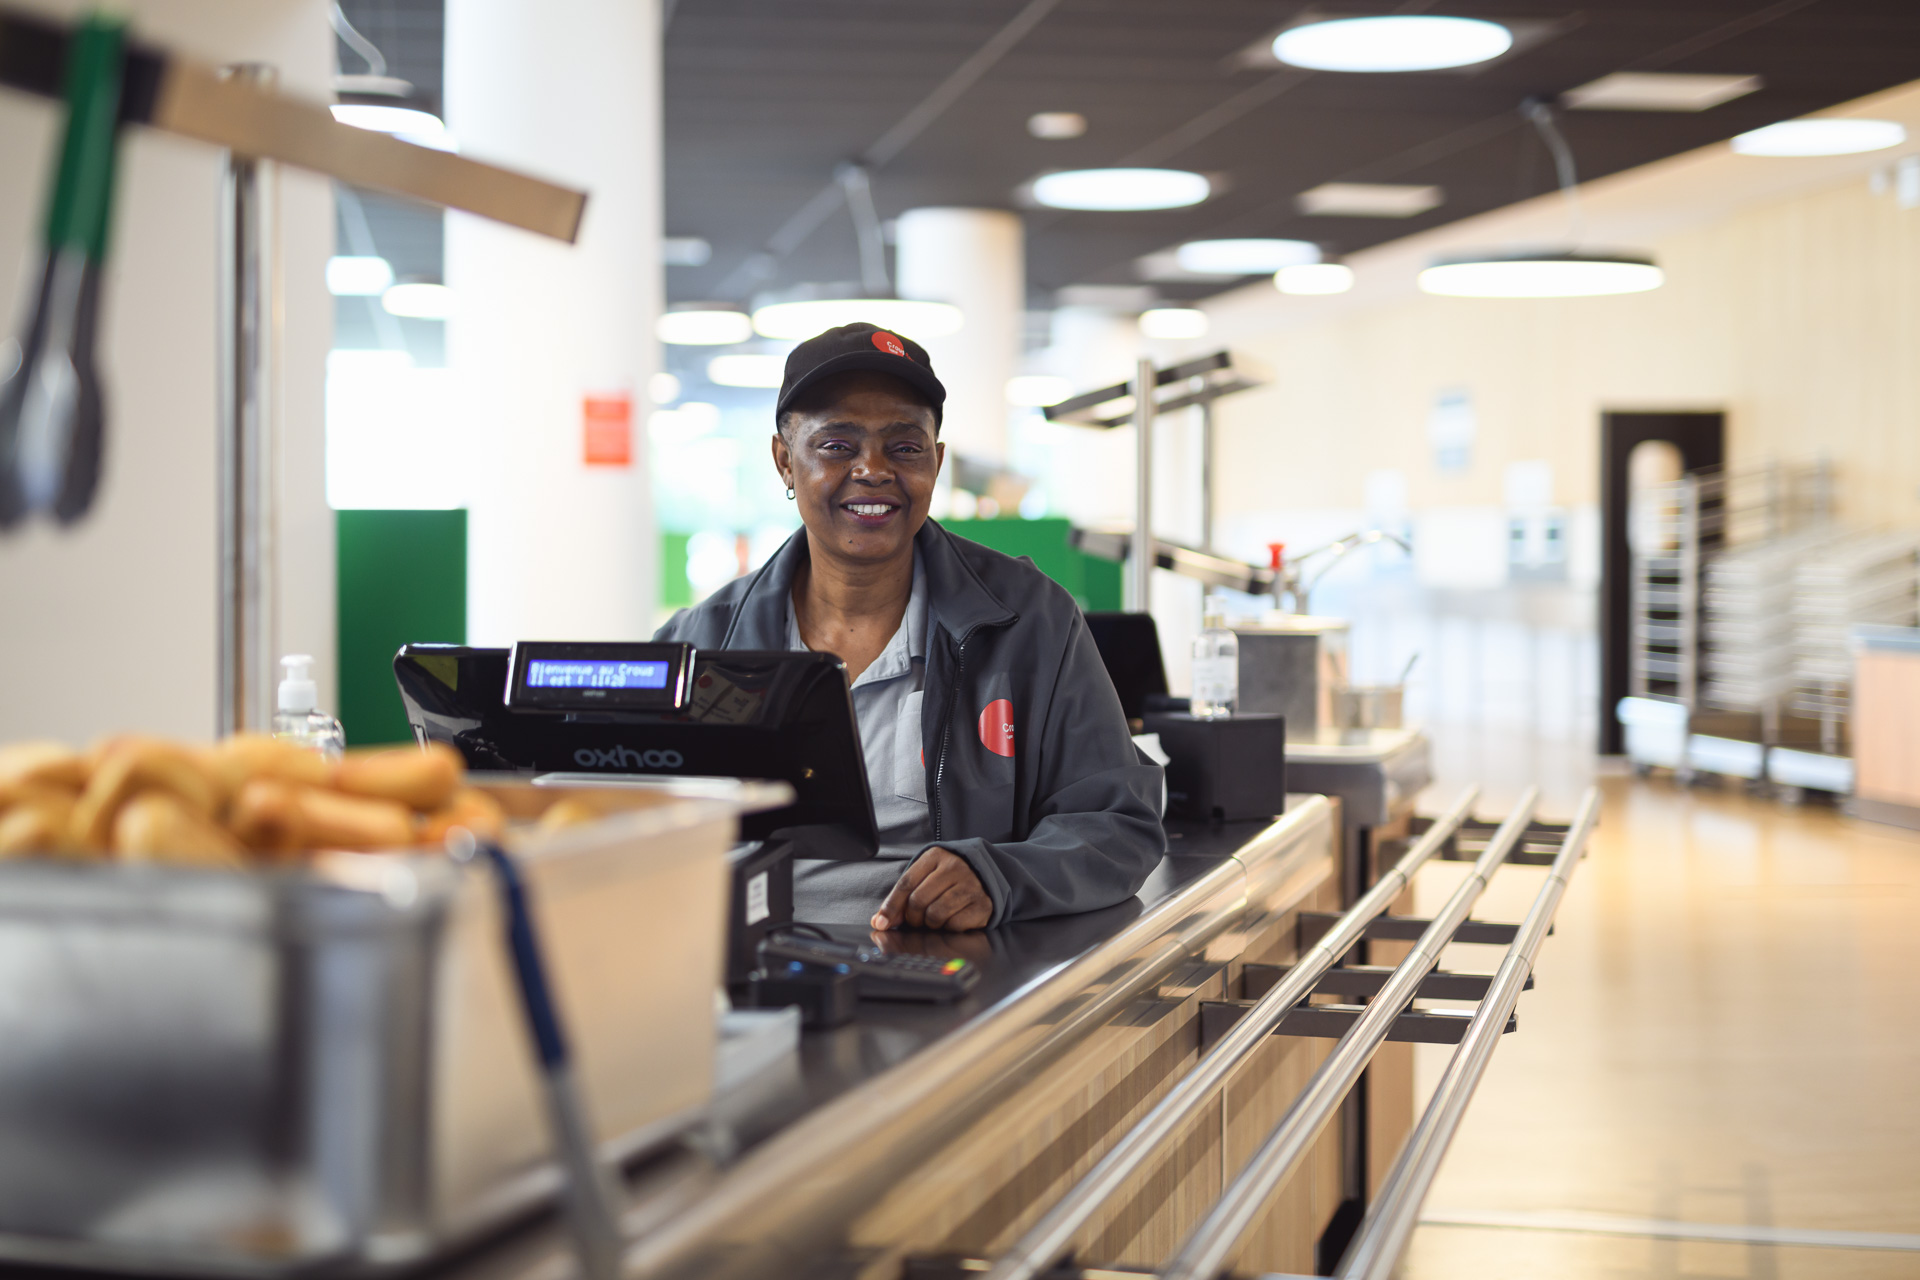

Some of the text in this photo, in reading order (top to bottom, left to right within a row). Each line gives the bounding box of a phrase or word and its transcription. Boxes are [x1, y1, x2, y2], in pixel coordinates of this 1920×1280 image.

[599, 665, 615, 676] au
[619, 662, 655, 677] Crous
[573, 744, 684, 769] oxhoo
